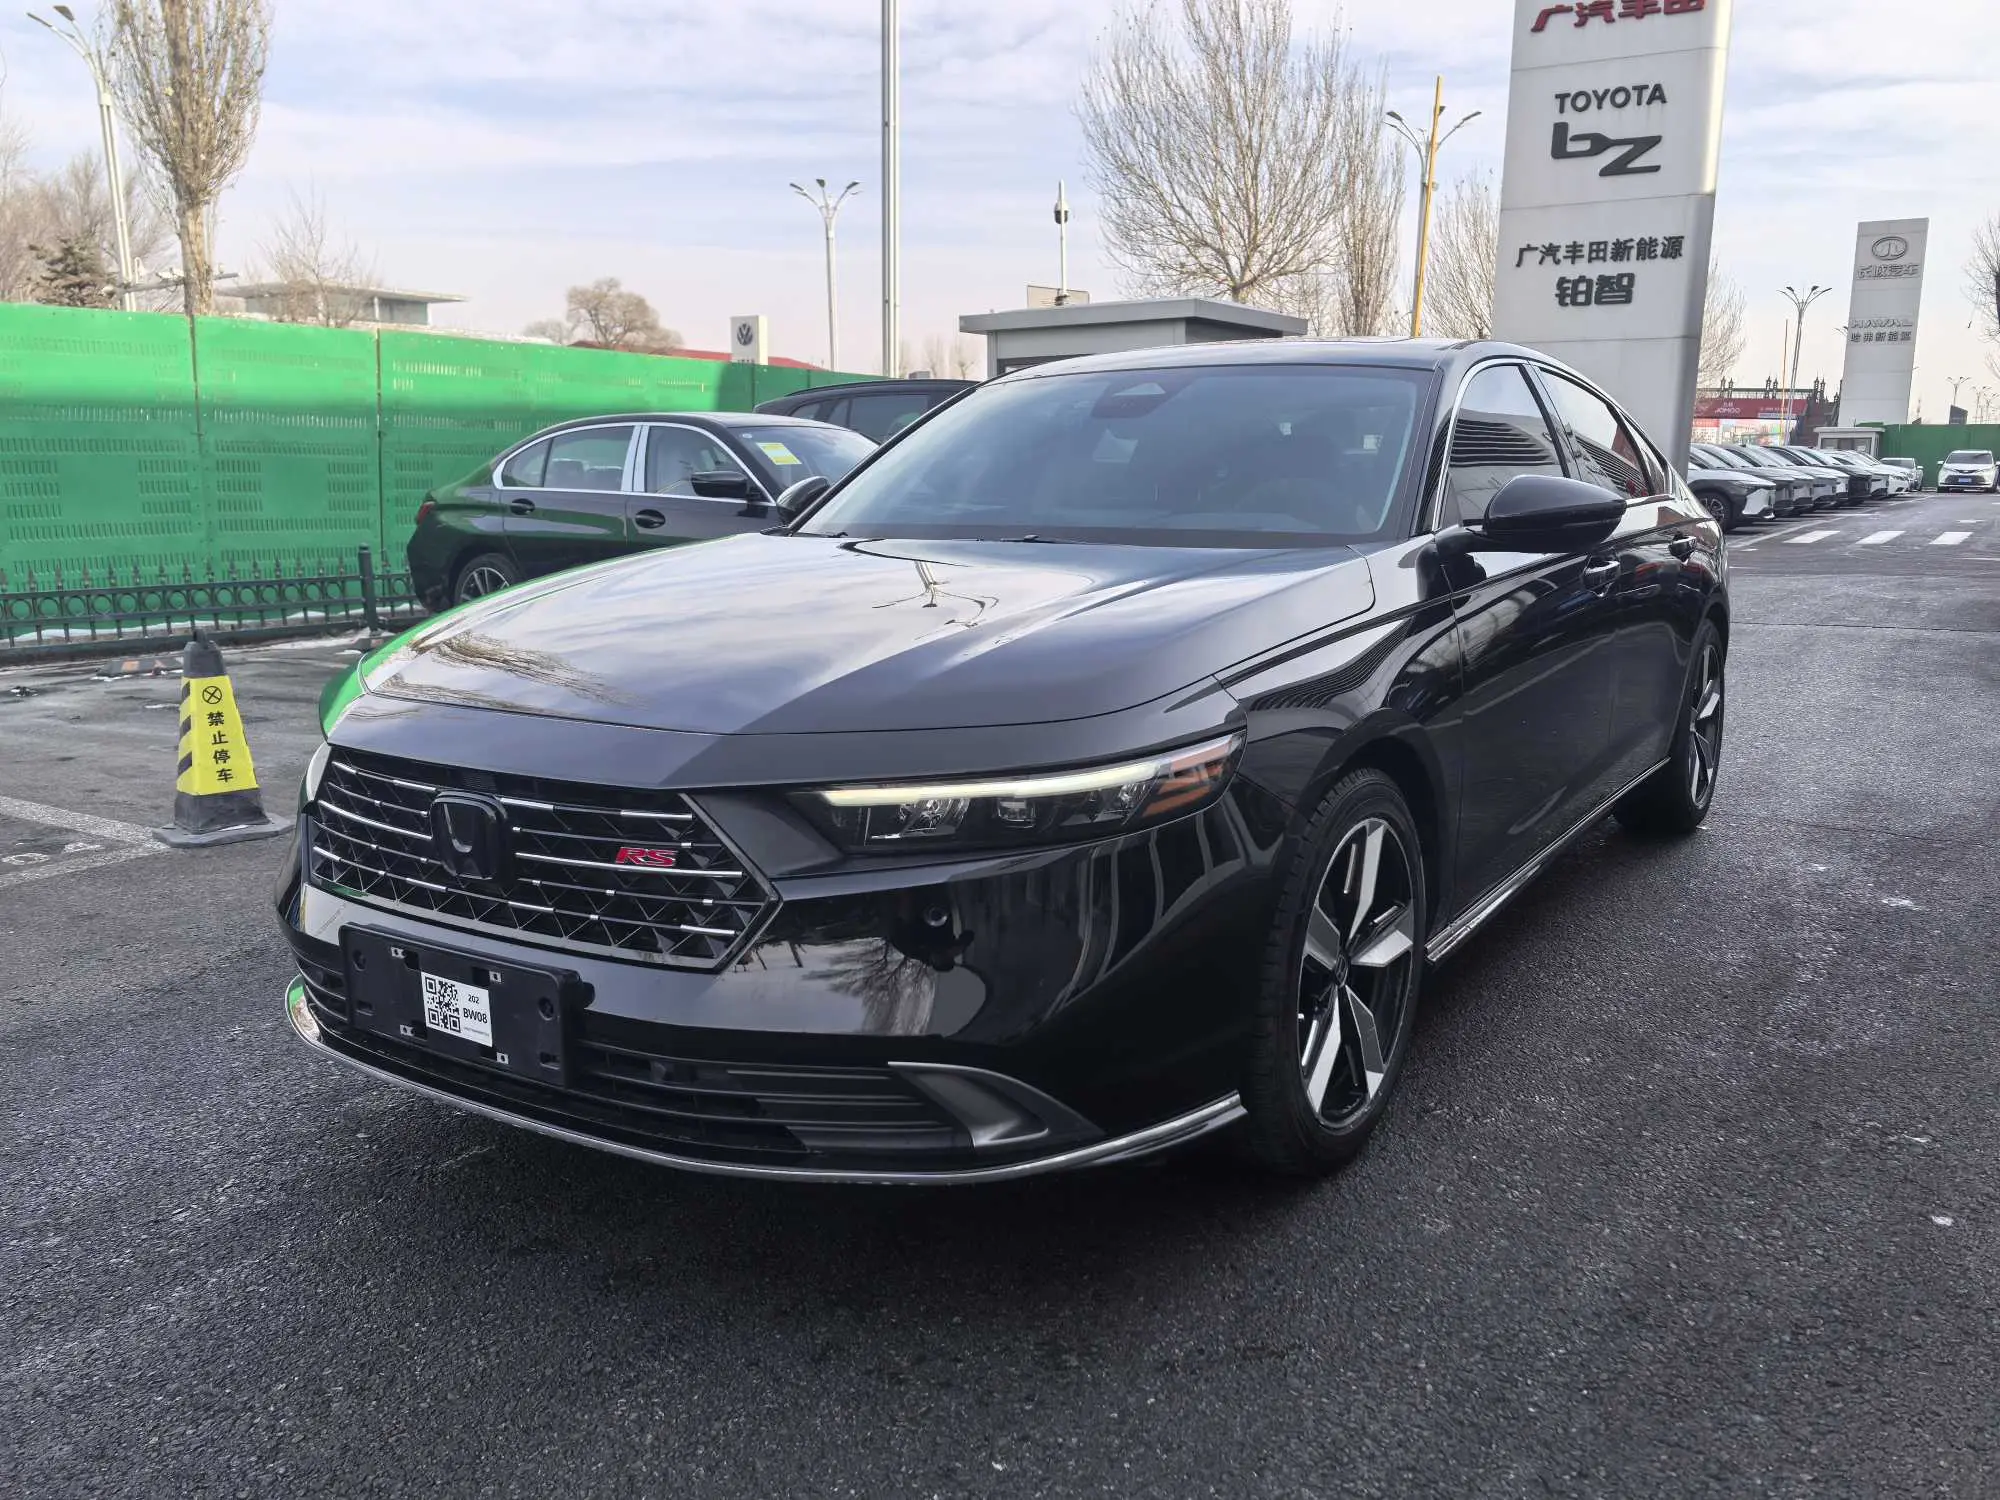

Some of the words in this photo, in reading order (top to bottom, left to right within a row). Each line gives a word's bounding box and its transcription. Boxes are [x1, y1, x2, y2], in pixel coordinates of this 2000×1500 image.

[1554, 83, 1668, 114] TOYOTA
[1515, 235, 1685, 268] 广汽丰田新能源
[1555, 272, 1636, 307] 铂智
[207, 710, 233, 783] 禁止停车
[615, 846, 678, 867] RS
[463, 1007, 488, 1024] BW08
